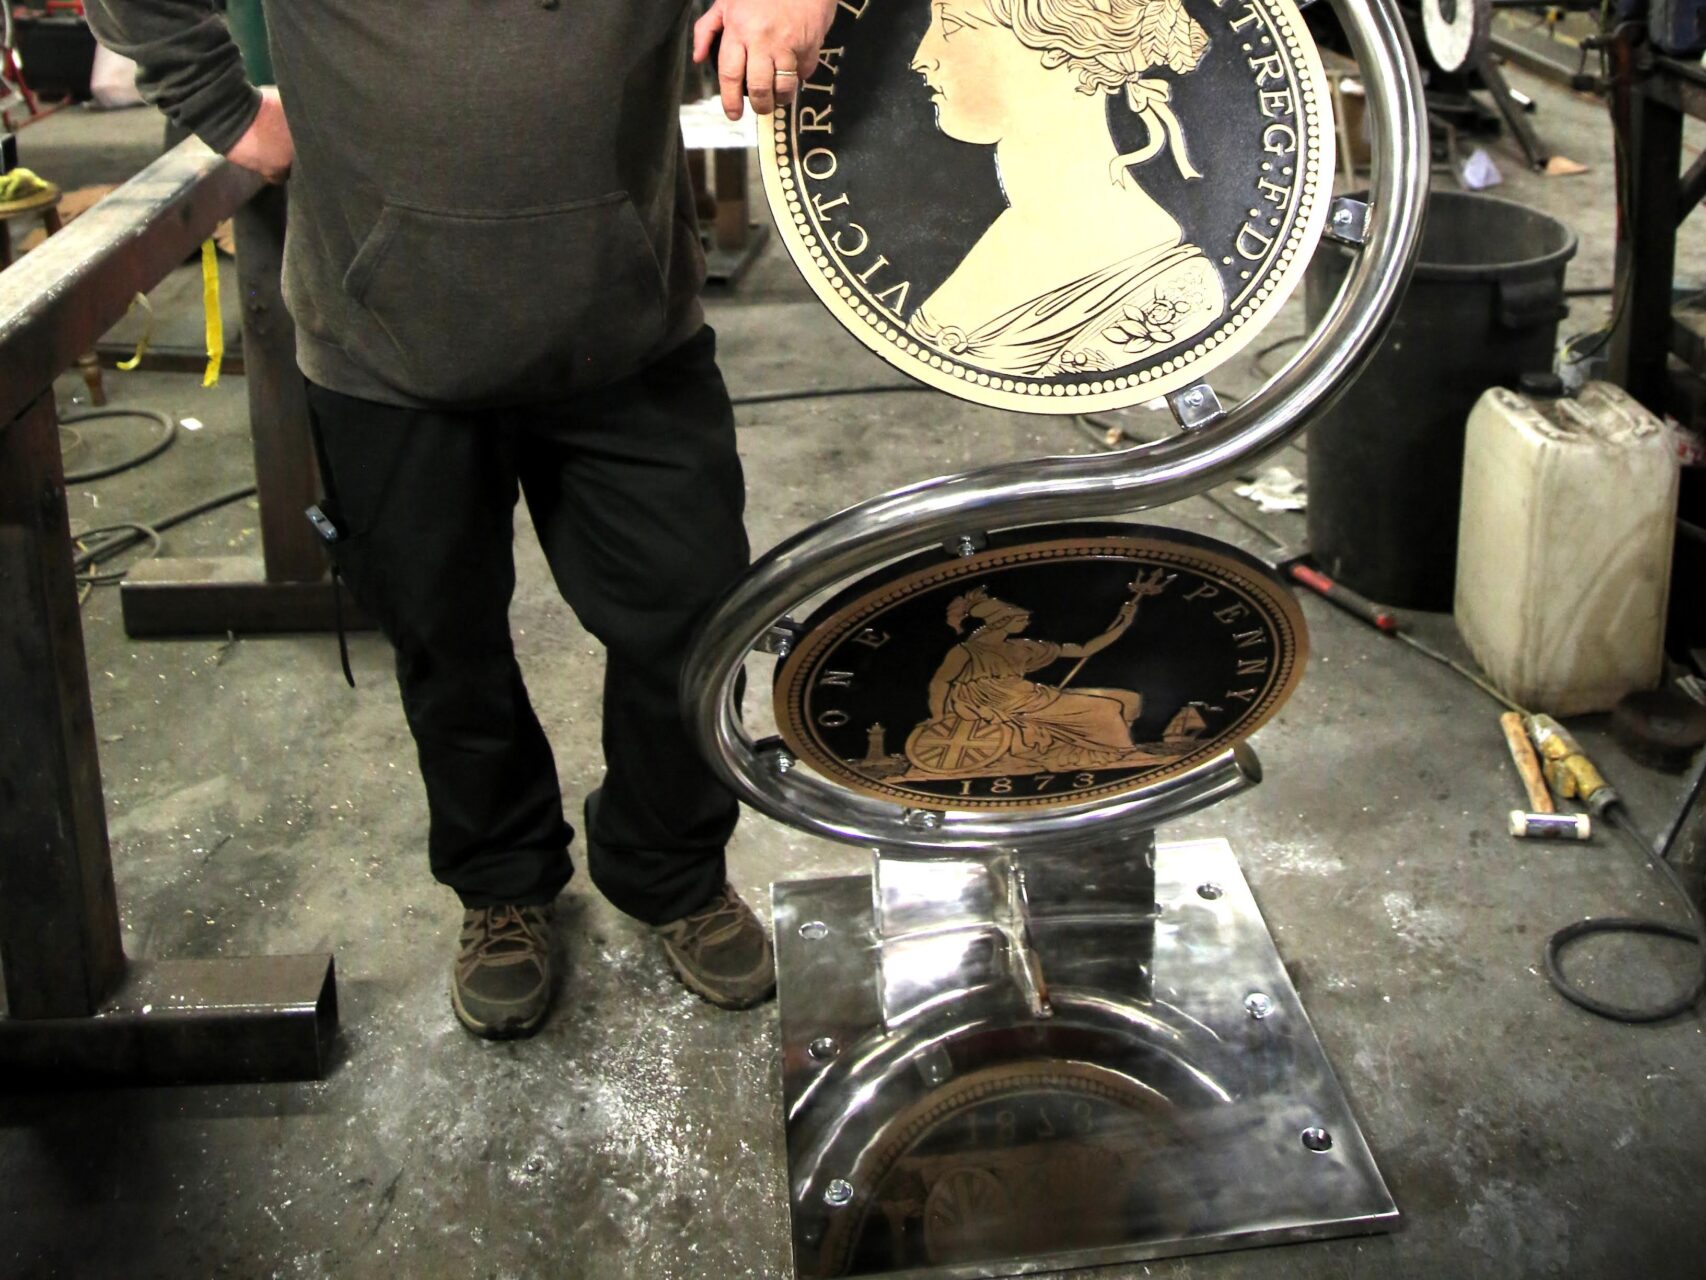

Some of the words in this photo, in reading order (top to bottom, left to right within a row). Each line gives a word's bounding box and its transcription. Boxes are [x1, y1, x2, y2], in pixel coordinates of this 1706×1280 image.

[800, 46, 911, 316] VICTORIA
[818, 628, 891, 728] ONE
[1183, 582, 1268, 703] PENNY
[959, 772, 1095, 796] 1873
